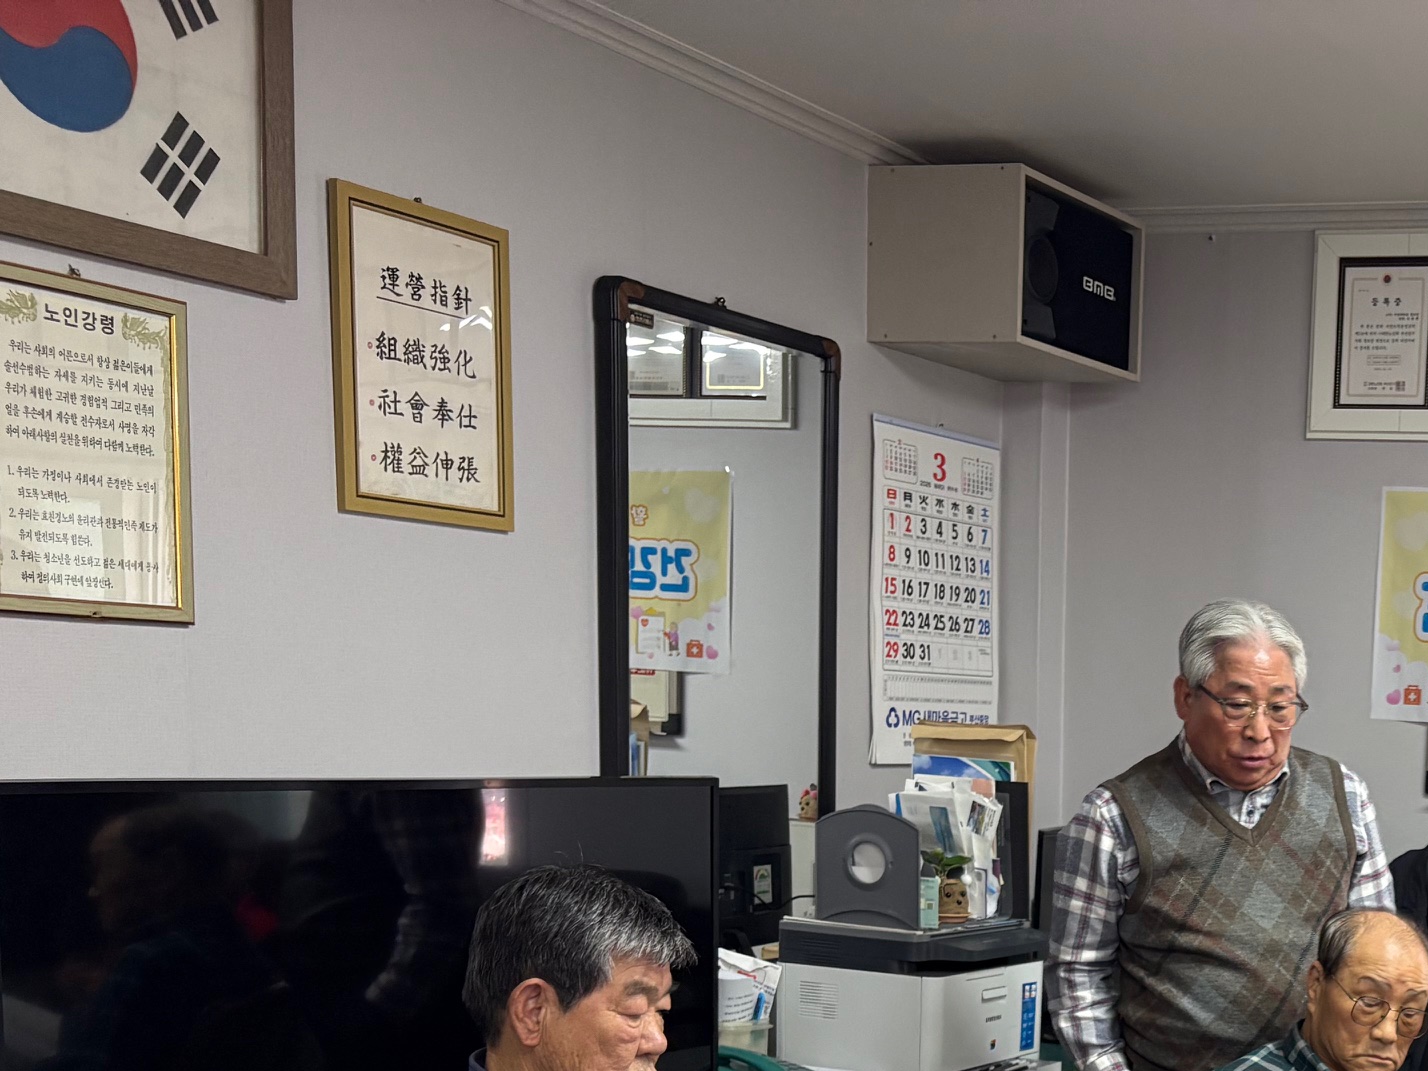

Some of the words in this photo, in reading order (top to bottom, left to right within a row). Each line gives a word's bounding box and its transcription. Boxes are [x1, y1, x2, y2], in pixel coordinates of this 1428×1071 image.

[381, 265, 472, 315] 運營指針
[43, 303, 115, 335] 노인강령
[9, 339, 31, 354] 우리는
[34, 344, 55, 359] 사회의
[58, 350, 93, 366] 어른으로서
[97, 357, 110, 371] 항상
[113, 359, 153, 377] 젊은이들에게
[376, 331, 477, 379] 組織強化
[5, 381, 27, 396] 우리가
[111, 400, 131, 413] 그리고
[134, 402, 154, 417] 민족의
[107, 377, 128, 393] 동시에
[133, 383, 154, 398] 지난날
[378, 389, 478, 429] 社會奉仕
[142, 425, 155, 437] 자각
[7, 465, 15, 476] 1.
[17, 466, 39, 479] 우리는
[379, 442, 481, 483] 權益伸張
[933, 453, 946, 482] 3
[9, 508, 16, 518] 2.
[18, 508, 39, 521] 우리는
[887, 489, 897, 499] 日
[904, 492, 912, 502] 月
[919, 495, 928, 506] 火
[935, 498, 944, 508] 水
[951, 502, 960, 511] 木
[966, 505, 974, 514] 金
[981, 508, 989, 518] 土
[890, 513, 894, 529] 1
[905, 515, 912, 532] 2
[920, 518, 927, 534] 3
[937, 521, 943, 538] 4
[952, 524, 958, 540] 5
[967, 527, 973, 542] 6
[982, 530, 987, 544] 7
[11, 550, 18, 560] 3.
[20, 550, 41, 562] 우리는
[889, 545, 895, 562] 8
[905, 548, 911, 564] 9
[918, 550, 929, 567] 10
[935, 553, 945, 569] 11
[950, 555, 961, 571] 12
[965, 558, 976, 573] 13
[980, 559, 989, 576] 14
[885, 577, 897, 594] 15
[902, 579, 913, 596] 16
[918, 582, 929, 598] 17
[934, 584, 945, 600] 18
[950, 585, 960, 602] 19
[964, 588, 976, 603] 20
[980, 590, 990, 606] 21
[885, 609, 899, 627] 22
[902, 611, 914, 627] 23
[918, 613, 930, 629] 24
[933, 615, 945, 631] 25
[949, 616, 960, 632] 26
[964, 618, 975, 634] 27
[979, 619, 990, 635] 28
[886, 641, 899, 658] 29
[902, 643, 915, 659] 30
[919, 645, 930, 661] 31
